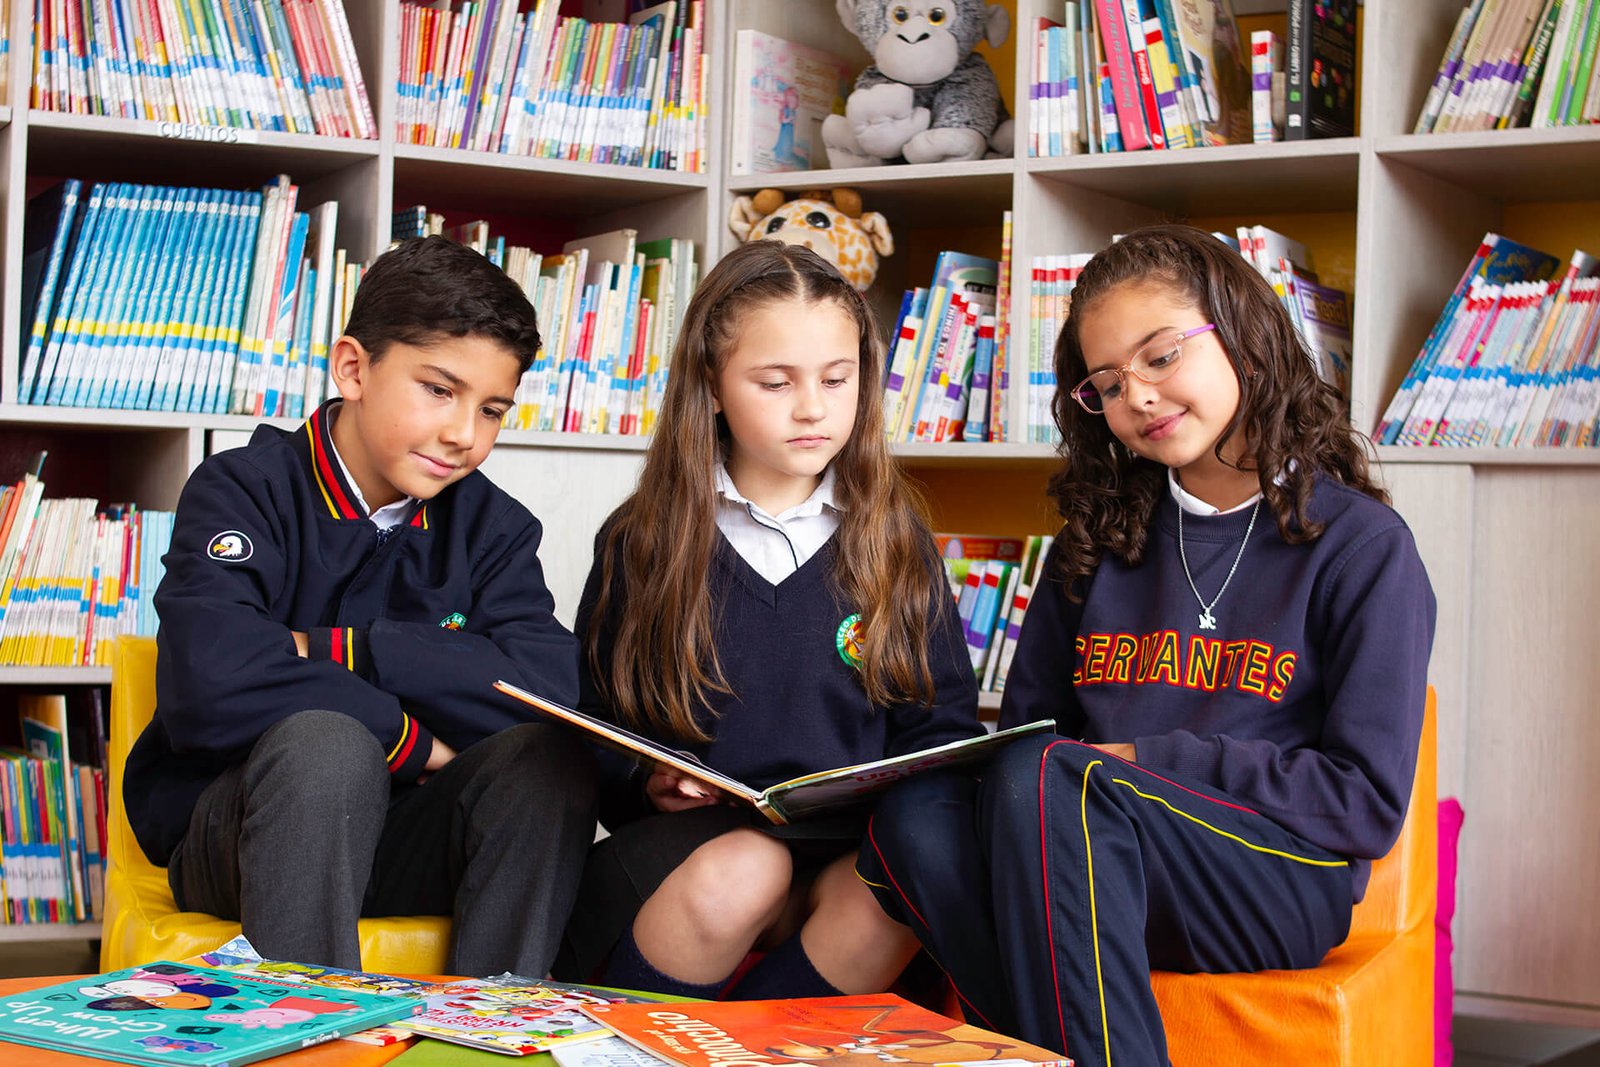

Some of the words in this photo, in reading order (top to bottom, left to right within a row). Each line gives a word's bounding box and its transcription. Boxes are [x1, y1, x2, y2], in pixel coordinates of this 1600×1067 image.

[161, 122, 239, 143] CUENTOS
[6, 1000, 54, 1017] Up
[13, 1016, 120, 1040] When
[62, 1011, 167, 1033] Grow
